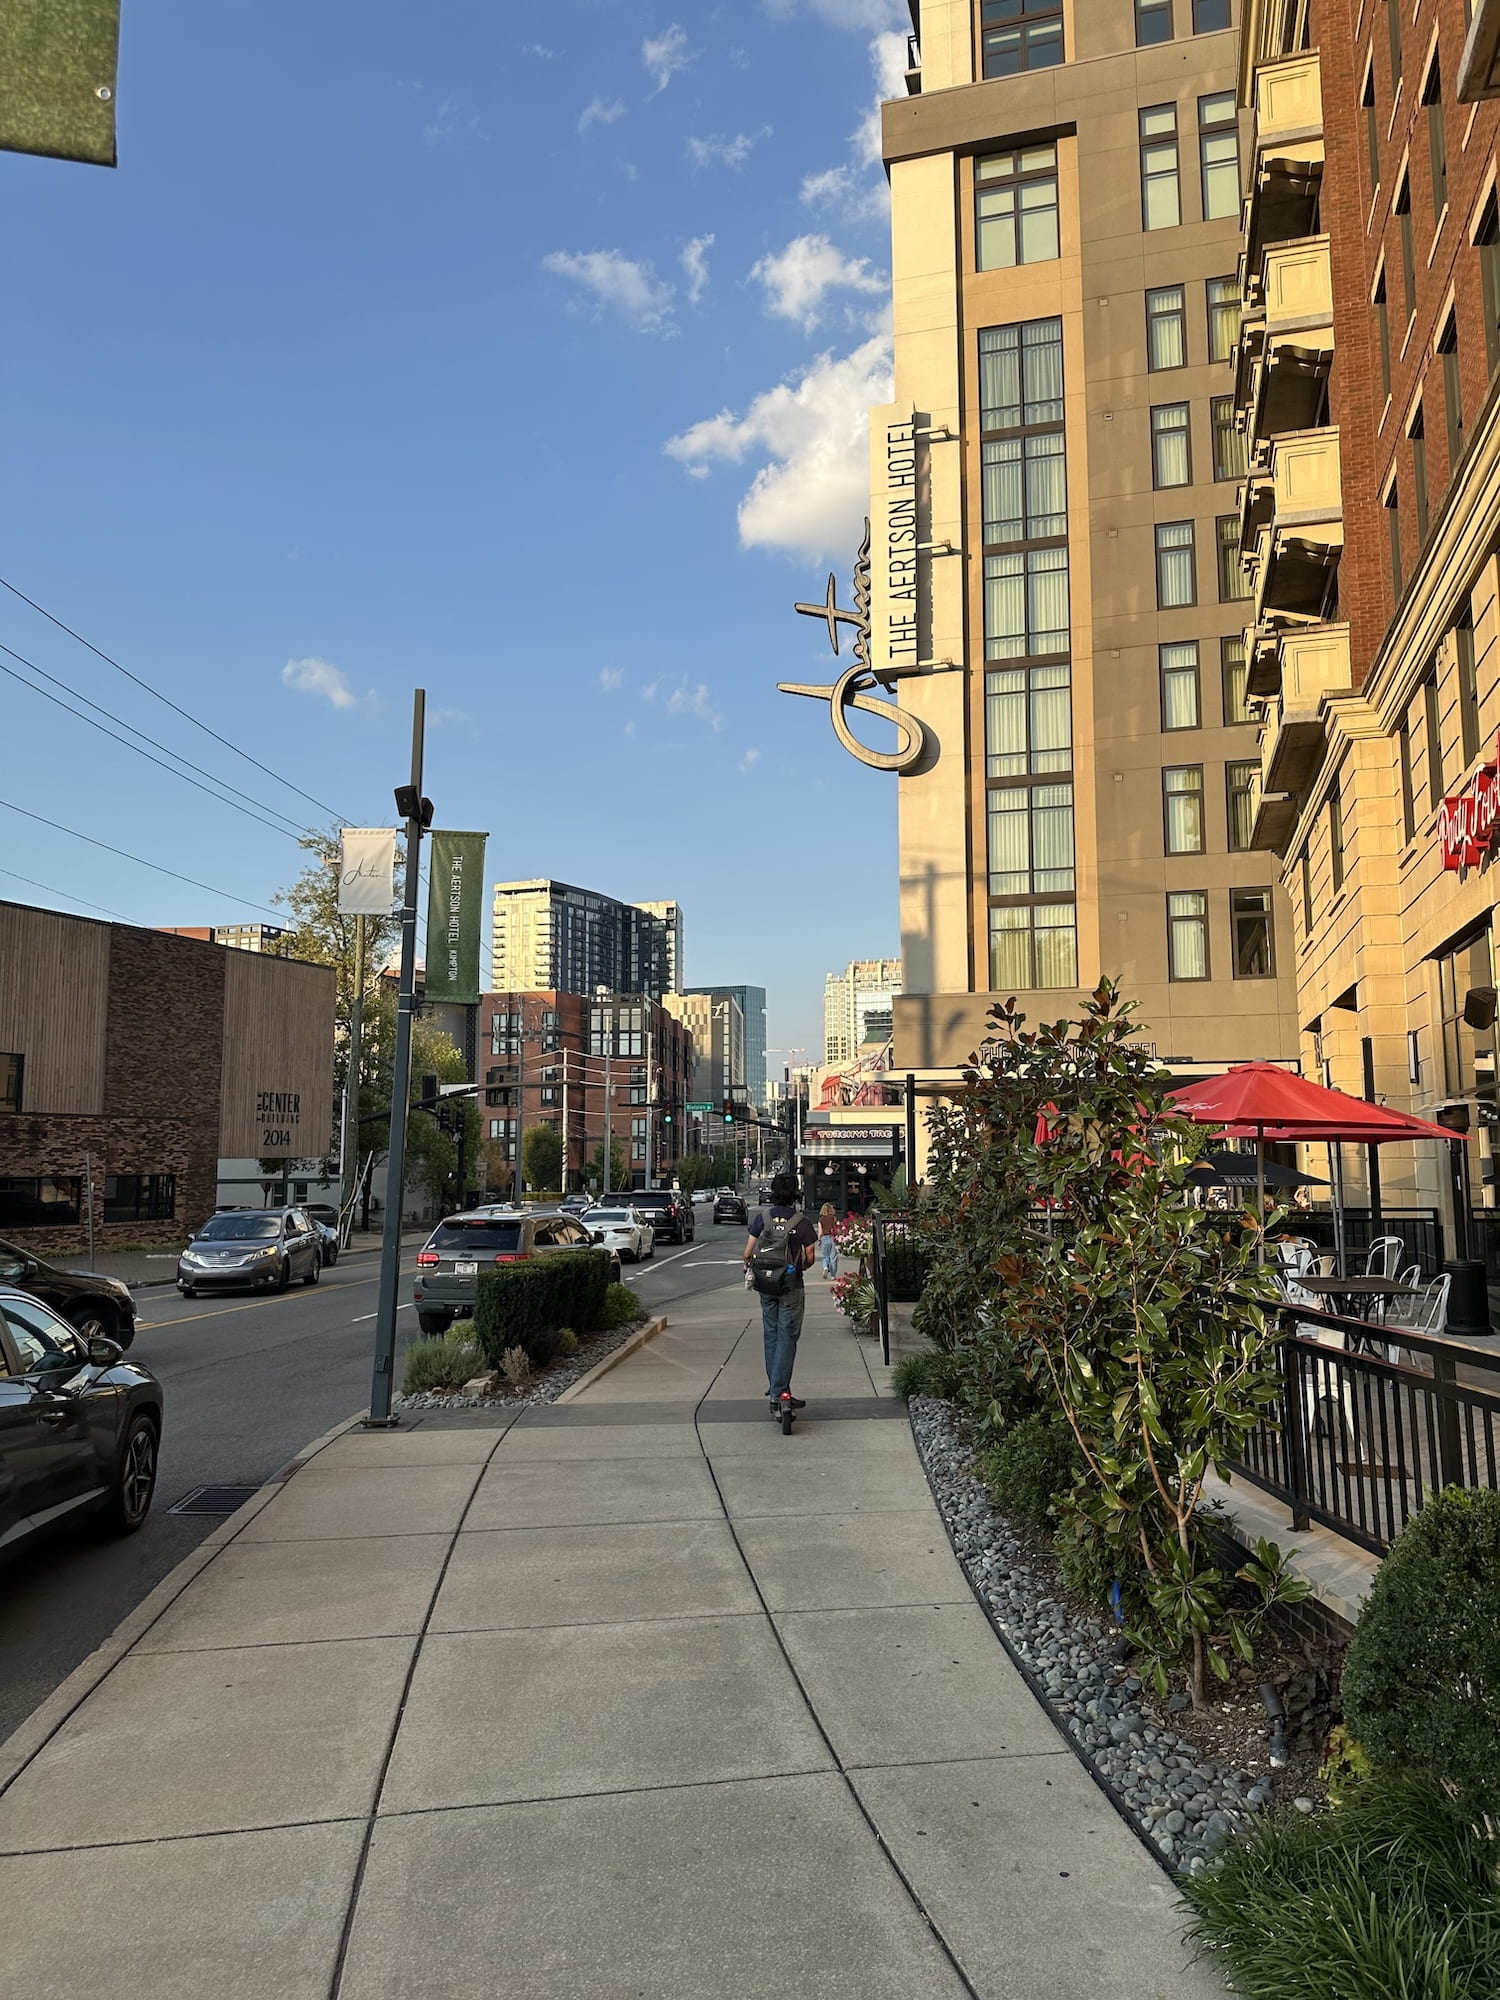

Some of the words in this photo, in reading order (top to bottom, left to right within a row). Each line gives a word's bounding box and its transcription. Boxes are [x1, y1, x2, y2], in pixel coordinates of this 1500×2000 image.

[887, 414, 916, 488] HOTEL
[888, 498, 917, 600] AERTSON
[889, 612, 918, 659] THE
[451, 855, 464, 872] THE
[449, 874, 463, 913] AERTSON
[447, 915, 460, 944] HOTEL
[447, 949, 458, 981] KIMPTON
[262, 1091, 300, 1113] CENTER
[262, 1129, 291, 1146] 2014
